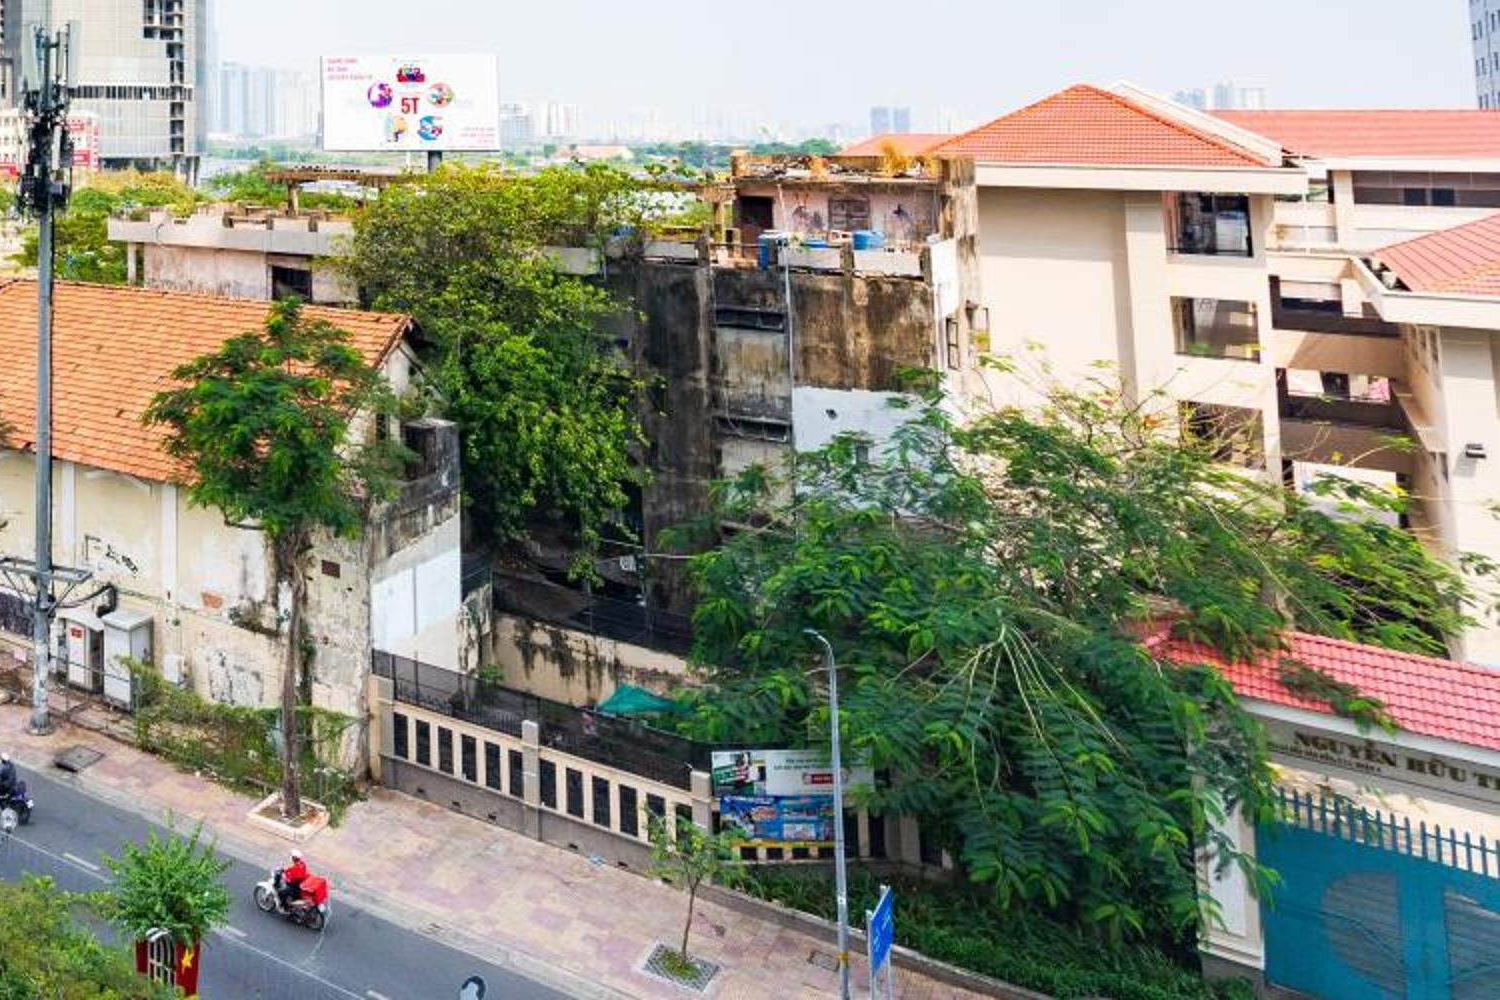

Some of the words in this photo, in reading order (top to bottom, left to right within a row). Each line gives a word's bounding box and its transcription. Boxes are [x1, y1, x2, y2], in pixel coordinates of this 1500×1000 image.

[401, 97, 420, 114] 5T
[1295, 729, 1398, 767] NGUYỄN
[1406, 756, 1467, 783] HỮU
